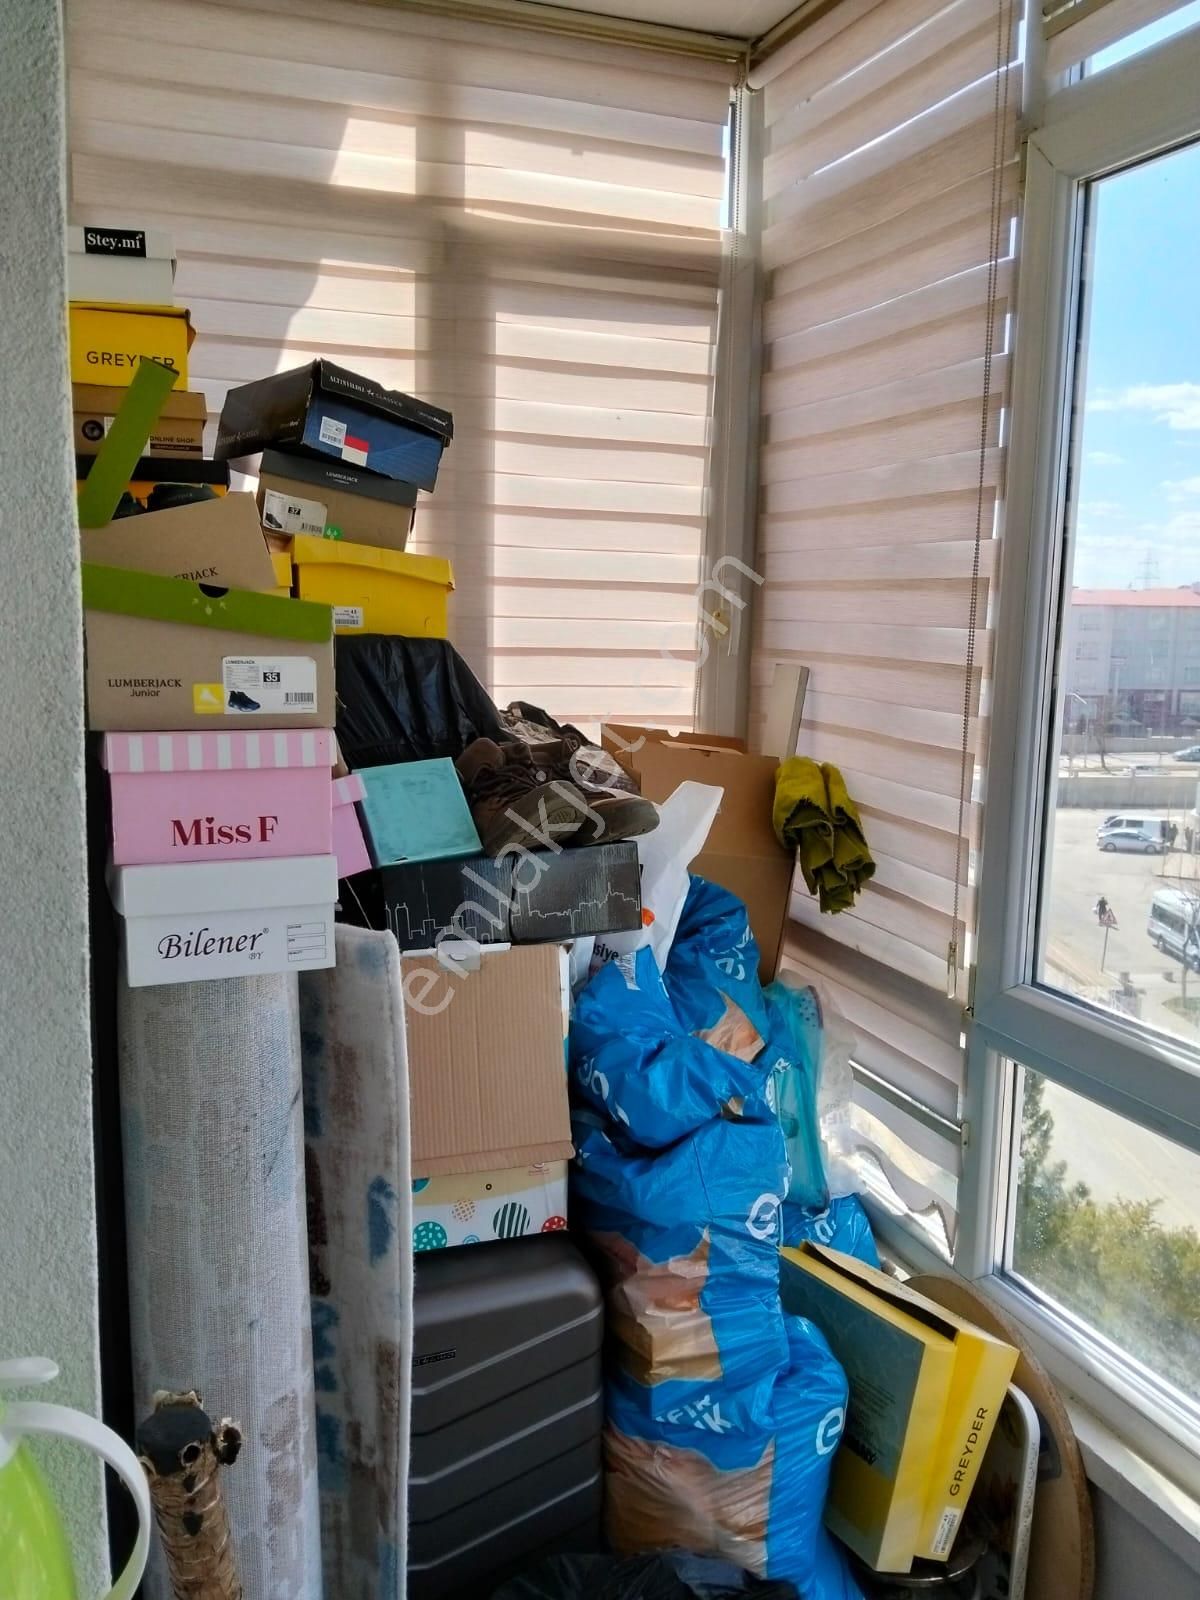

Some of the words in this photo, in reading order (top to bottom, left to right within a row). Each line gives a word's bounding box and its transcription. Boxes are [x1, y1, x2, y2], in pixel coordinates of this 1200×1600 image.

[87, 232, 143, 250] Stey.mi
[86, 351, 175, 367] GREYR
[108, 679, 182, 689] LUMBERJACK
[265, 673, 278, 682] 35
[130, 688, 160, 697] Junior
[171, 816, 252, 846] Miss
[257, 816, 279, 842] F
[950, 1407, 988, 1497] GREYDER
